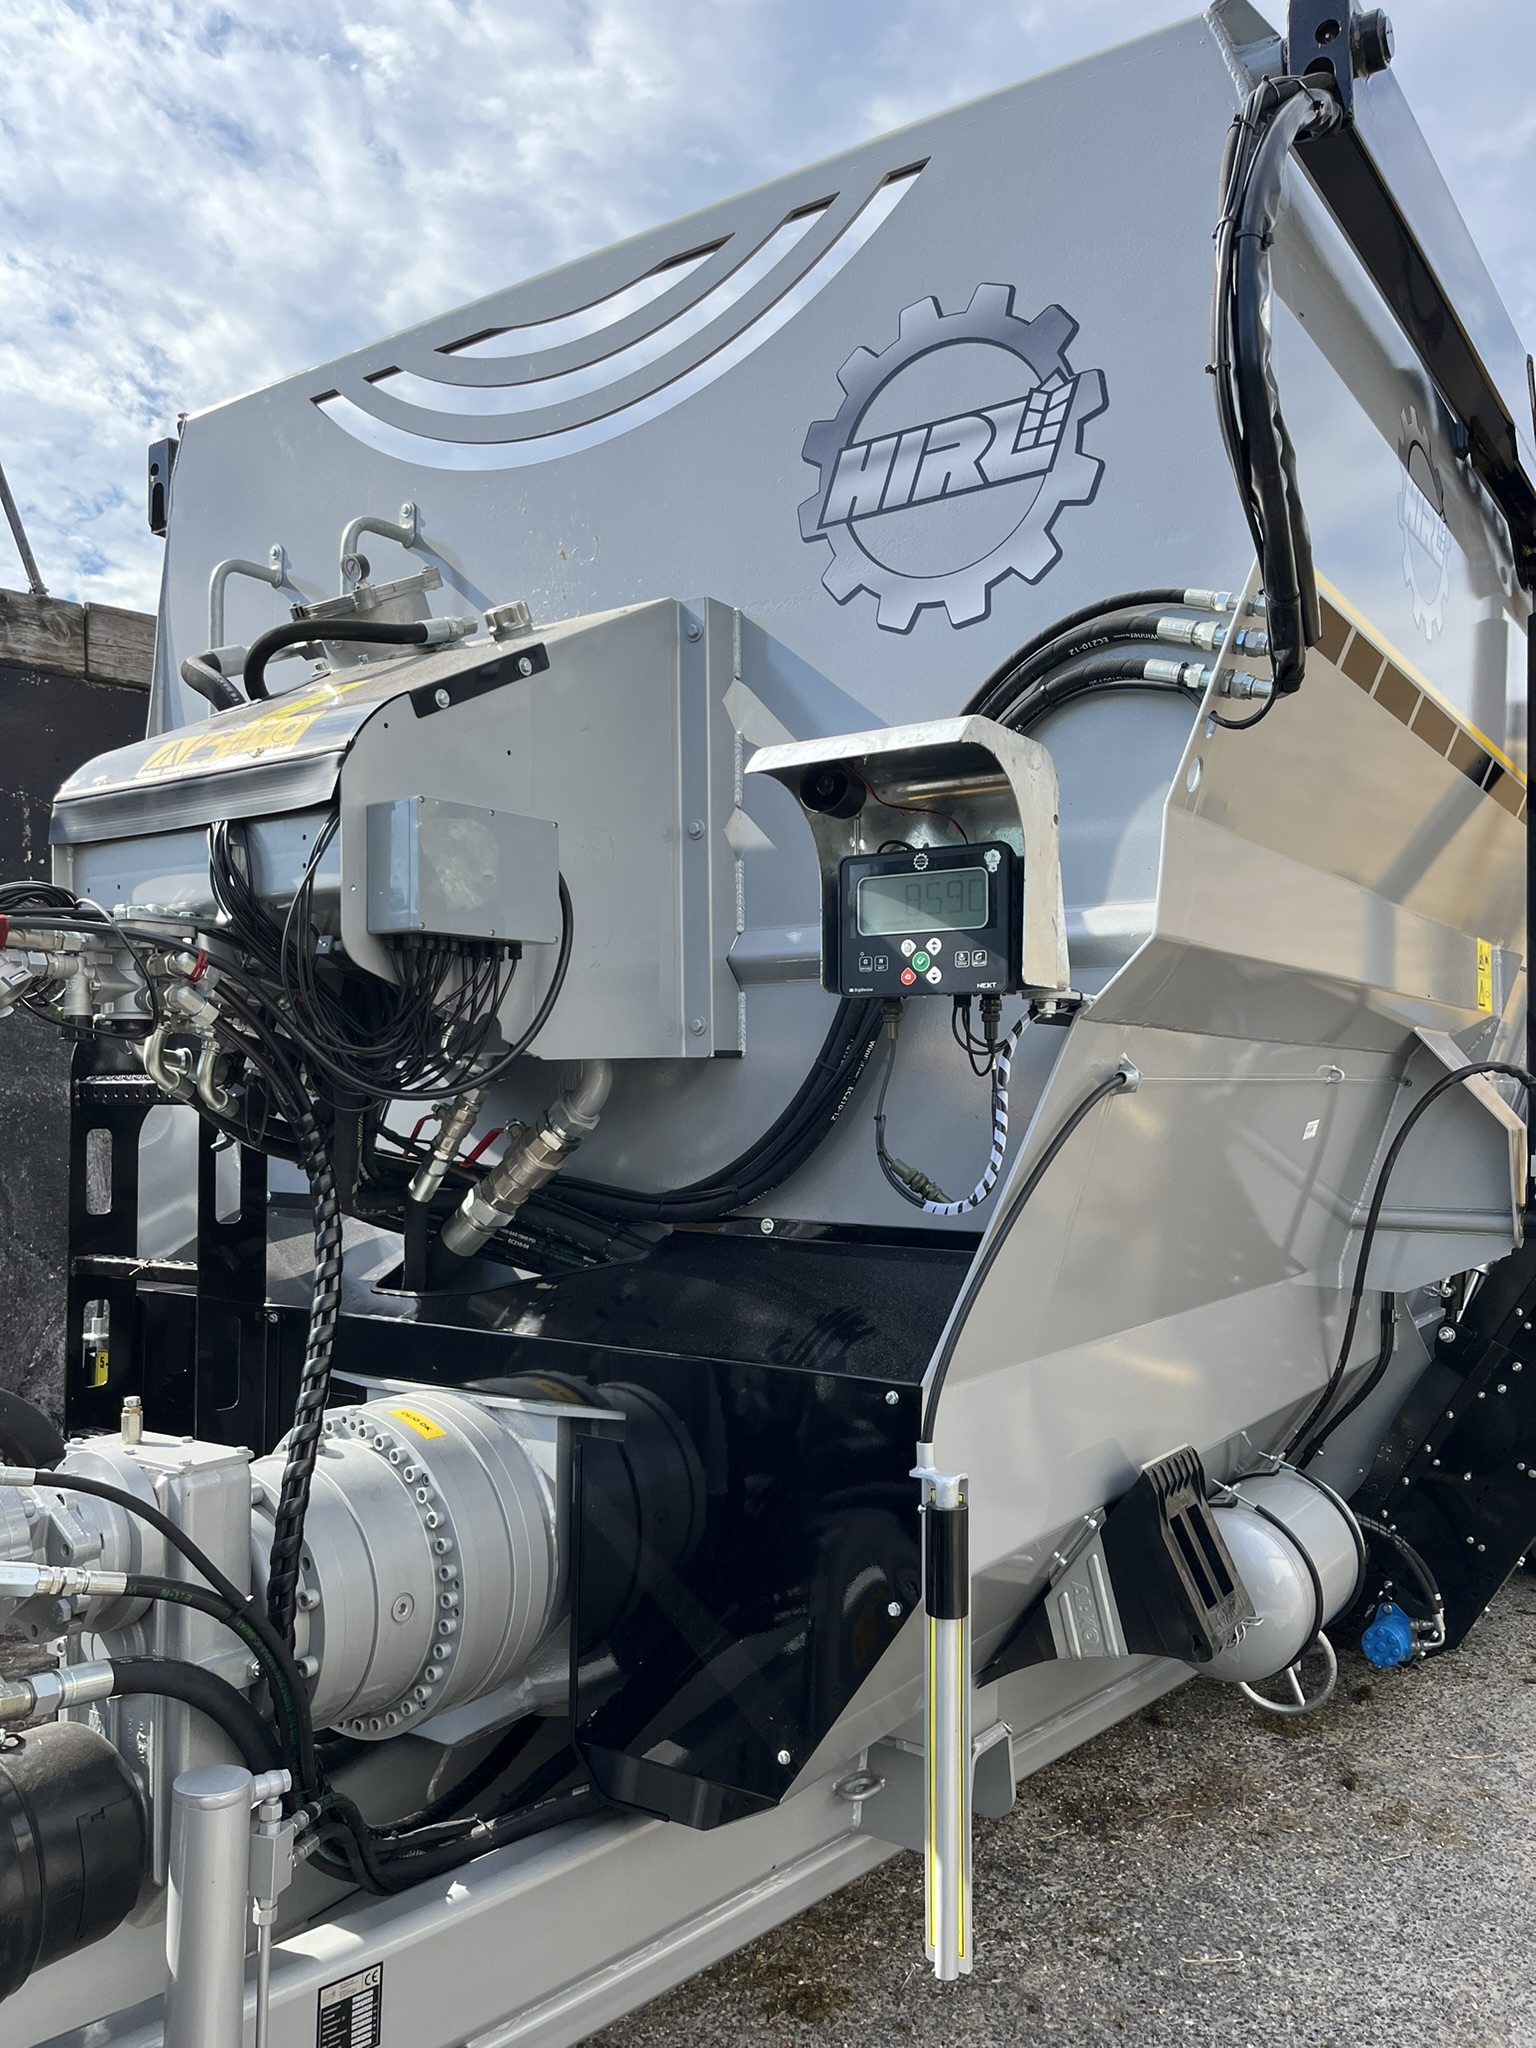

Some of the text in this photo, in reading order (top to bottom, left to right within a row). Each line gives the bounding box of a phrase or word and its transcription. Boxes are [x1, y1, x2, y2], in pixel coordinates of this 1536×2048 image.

[1068, 636, 1111, 656] EC210-12
[904, 878, 984, 916] 8590
[830, 1086, 854, 1121] EC210-12
[100, 1356, 105, 1369] 5
[420, 1422, 432, 1431] OK
[365, 1969, 378, 1986] CE
